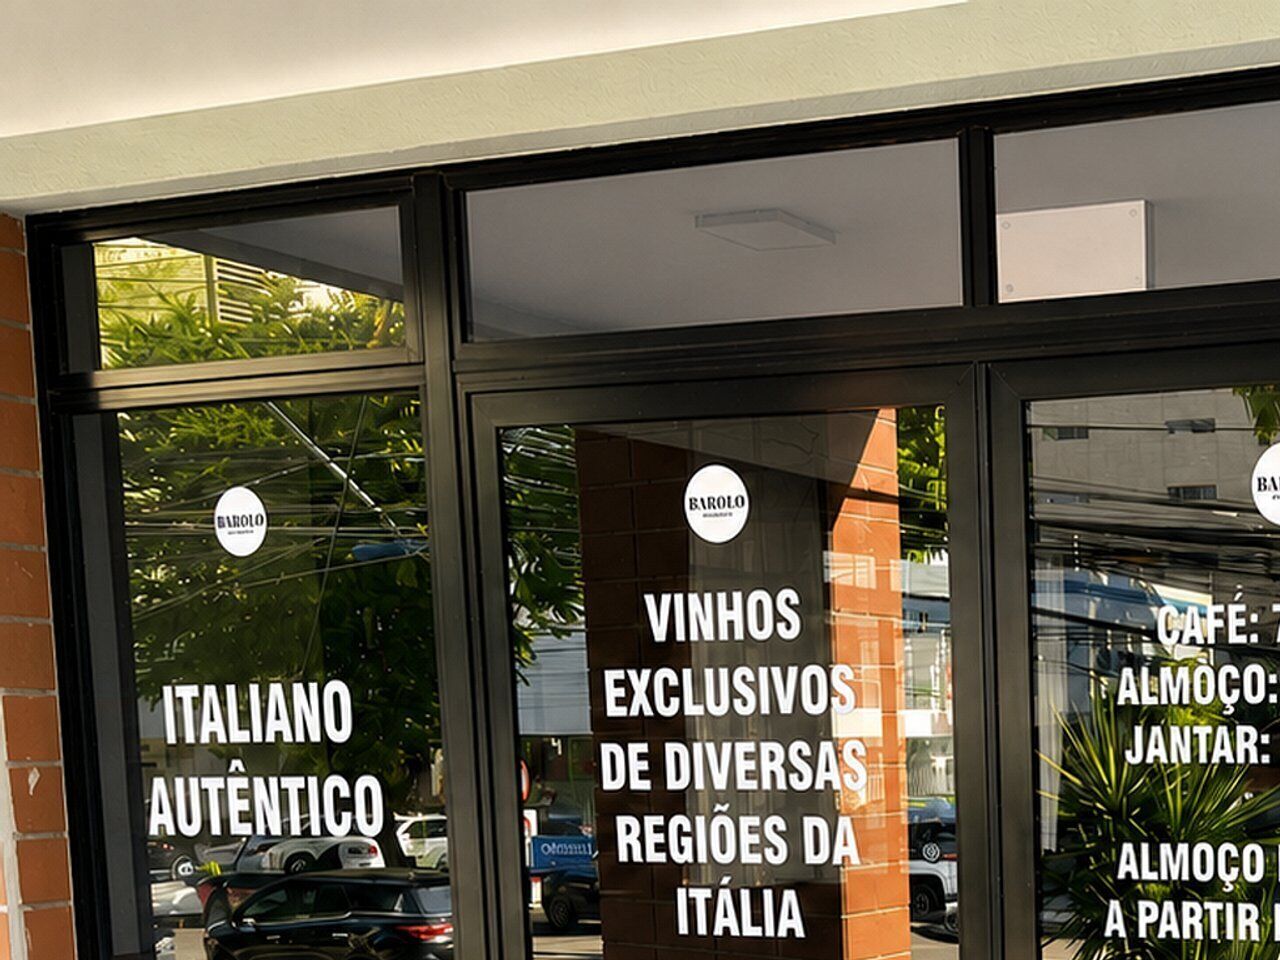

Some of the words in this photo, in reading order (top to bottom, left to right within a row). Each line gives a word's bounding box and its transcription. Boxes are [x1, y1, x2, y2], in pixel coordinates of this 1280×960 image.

[217, 513, 264, 529] BAROLO
[688, 494, 746, 511] BAROLO
[644, 588, 800, 642] VINHOS
[1157, 591, 1259, 645] CAFÉ:
[162, 679, 352, 744] ITALIANO
[604, 664, 856, 717] EXCLUSIVOS
[1117, 663, 1278, 715] ALMOÇO:
[600, 742, 651, 792] DE
[666, 739, 868, 792] DIVERSAS
[1124, 724, 1271, 766] JANTAR:
[148, 759, 384, 837] AUTÊNTICO
[615, 803, 788, 864] REGIÕES
[803, 815, 861, 866] DA
[1117, 841, 1265, 892] ALMOÇO
[676, 876, 805, 938] ITÁLIA
[1104, 900, 1127, 939] A
[1138, 900, 1261, 943] PARTIR
